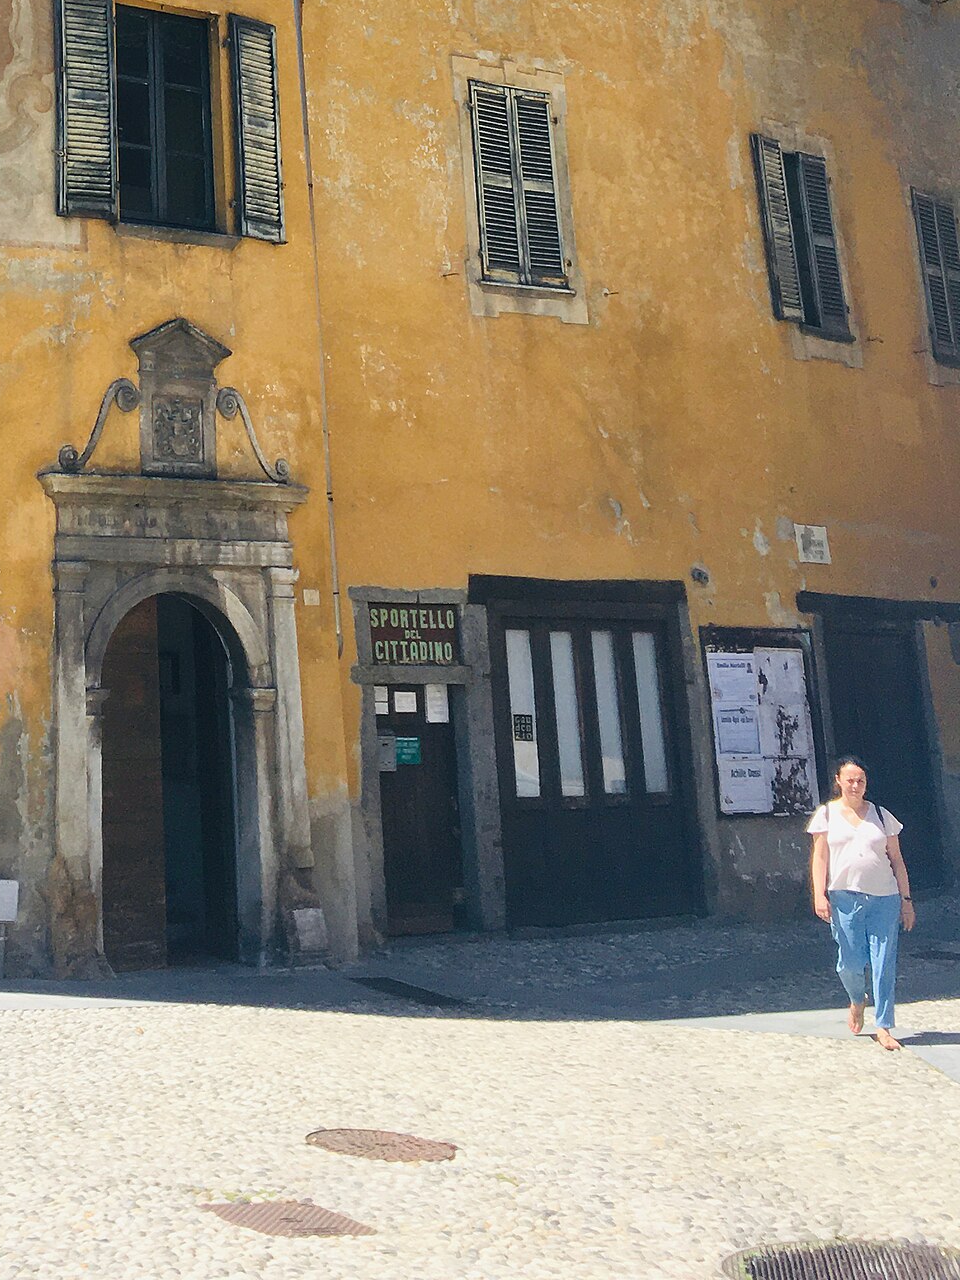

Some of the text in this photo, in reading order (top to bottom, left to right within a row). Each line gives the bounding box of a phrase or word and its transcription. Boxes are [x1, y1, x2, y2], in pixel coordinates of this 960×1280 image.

[370, 608, 455, 629] SPORTELLO
[404, 629, 421, 640] DEL
[375, 640, 453, 661] CITTADINO
